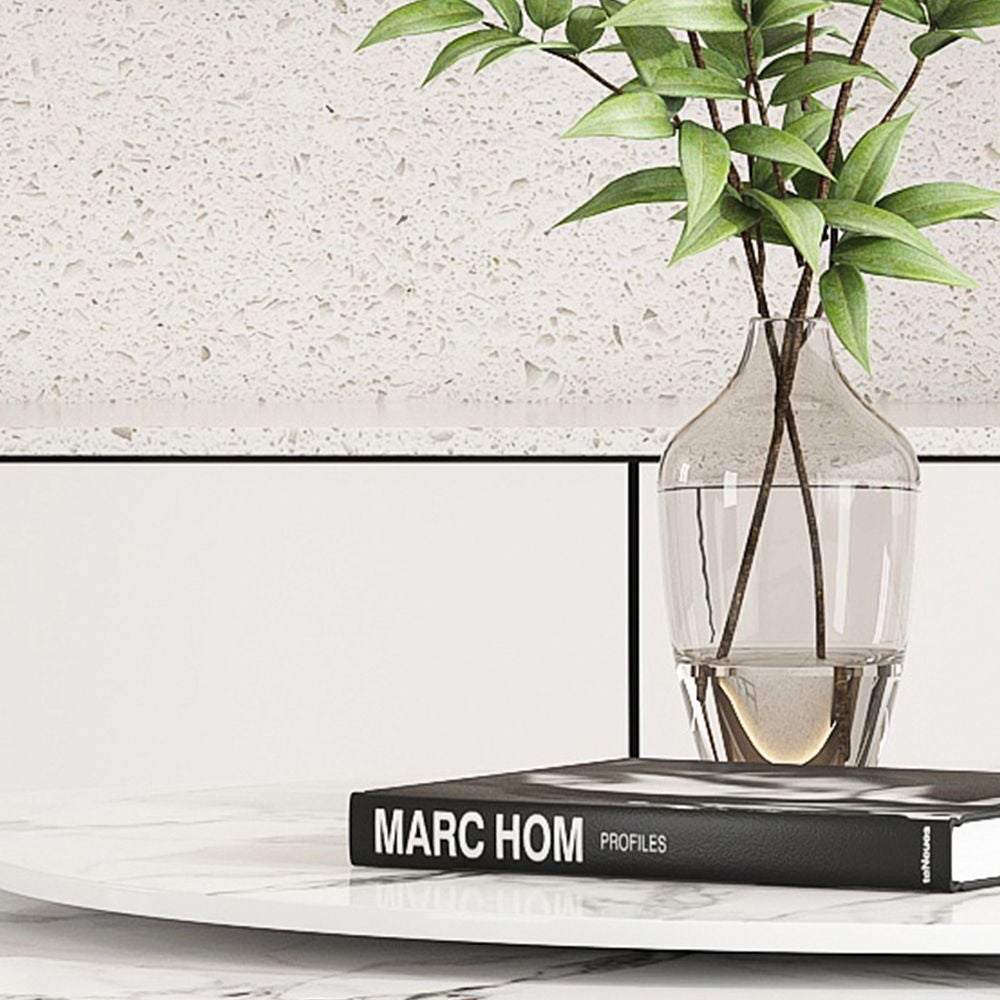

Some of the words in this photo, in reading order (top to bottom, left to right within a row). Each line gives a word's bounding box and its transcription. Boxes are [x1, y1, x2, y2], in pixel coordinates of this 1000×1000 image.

[374, 808, 485, 860] MARC
[495, 813, 584, 863] HOM
[599, 831, 667, 854] PROFILES
